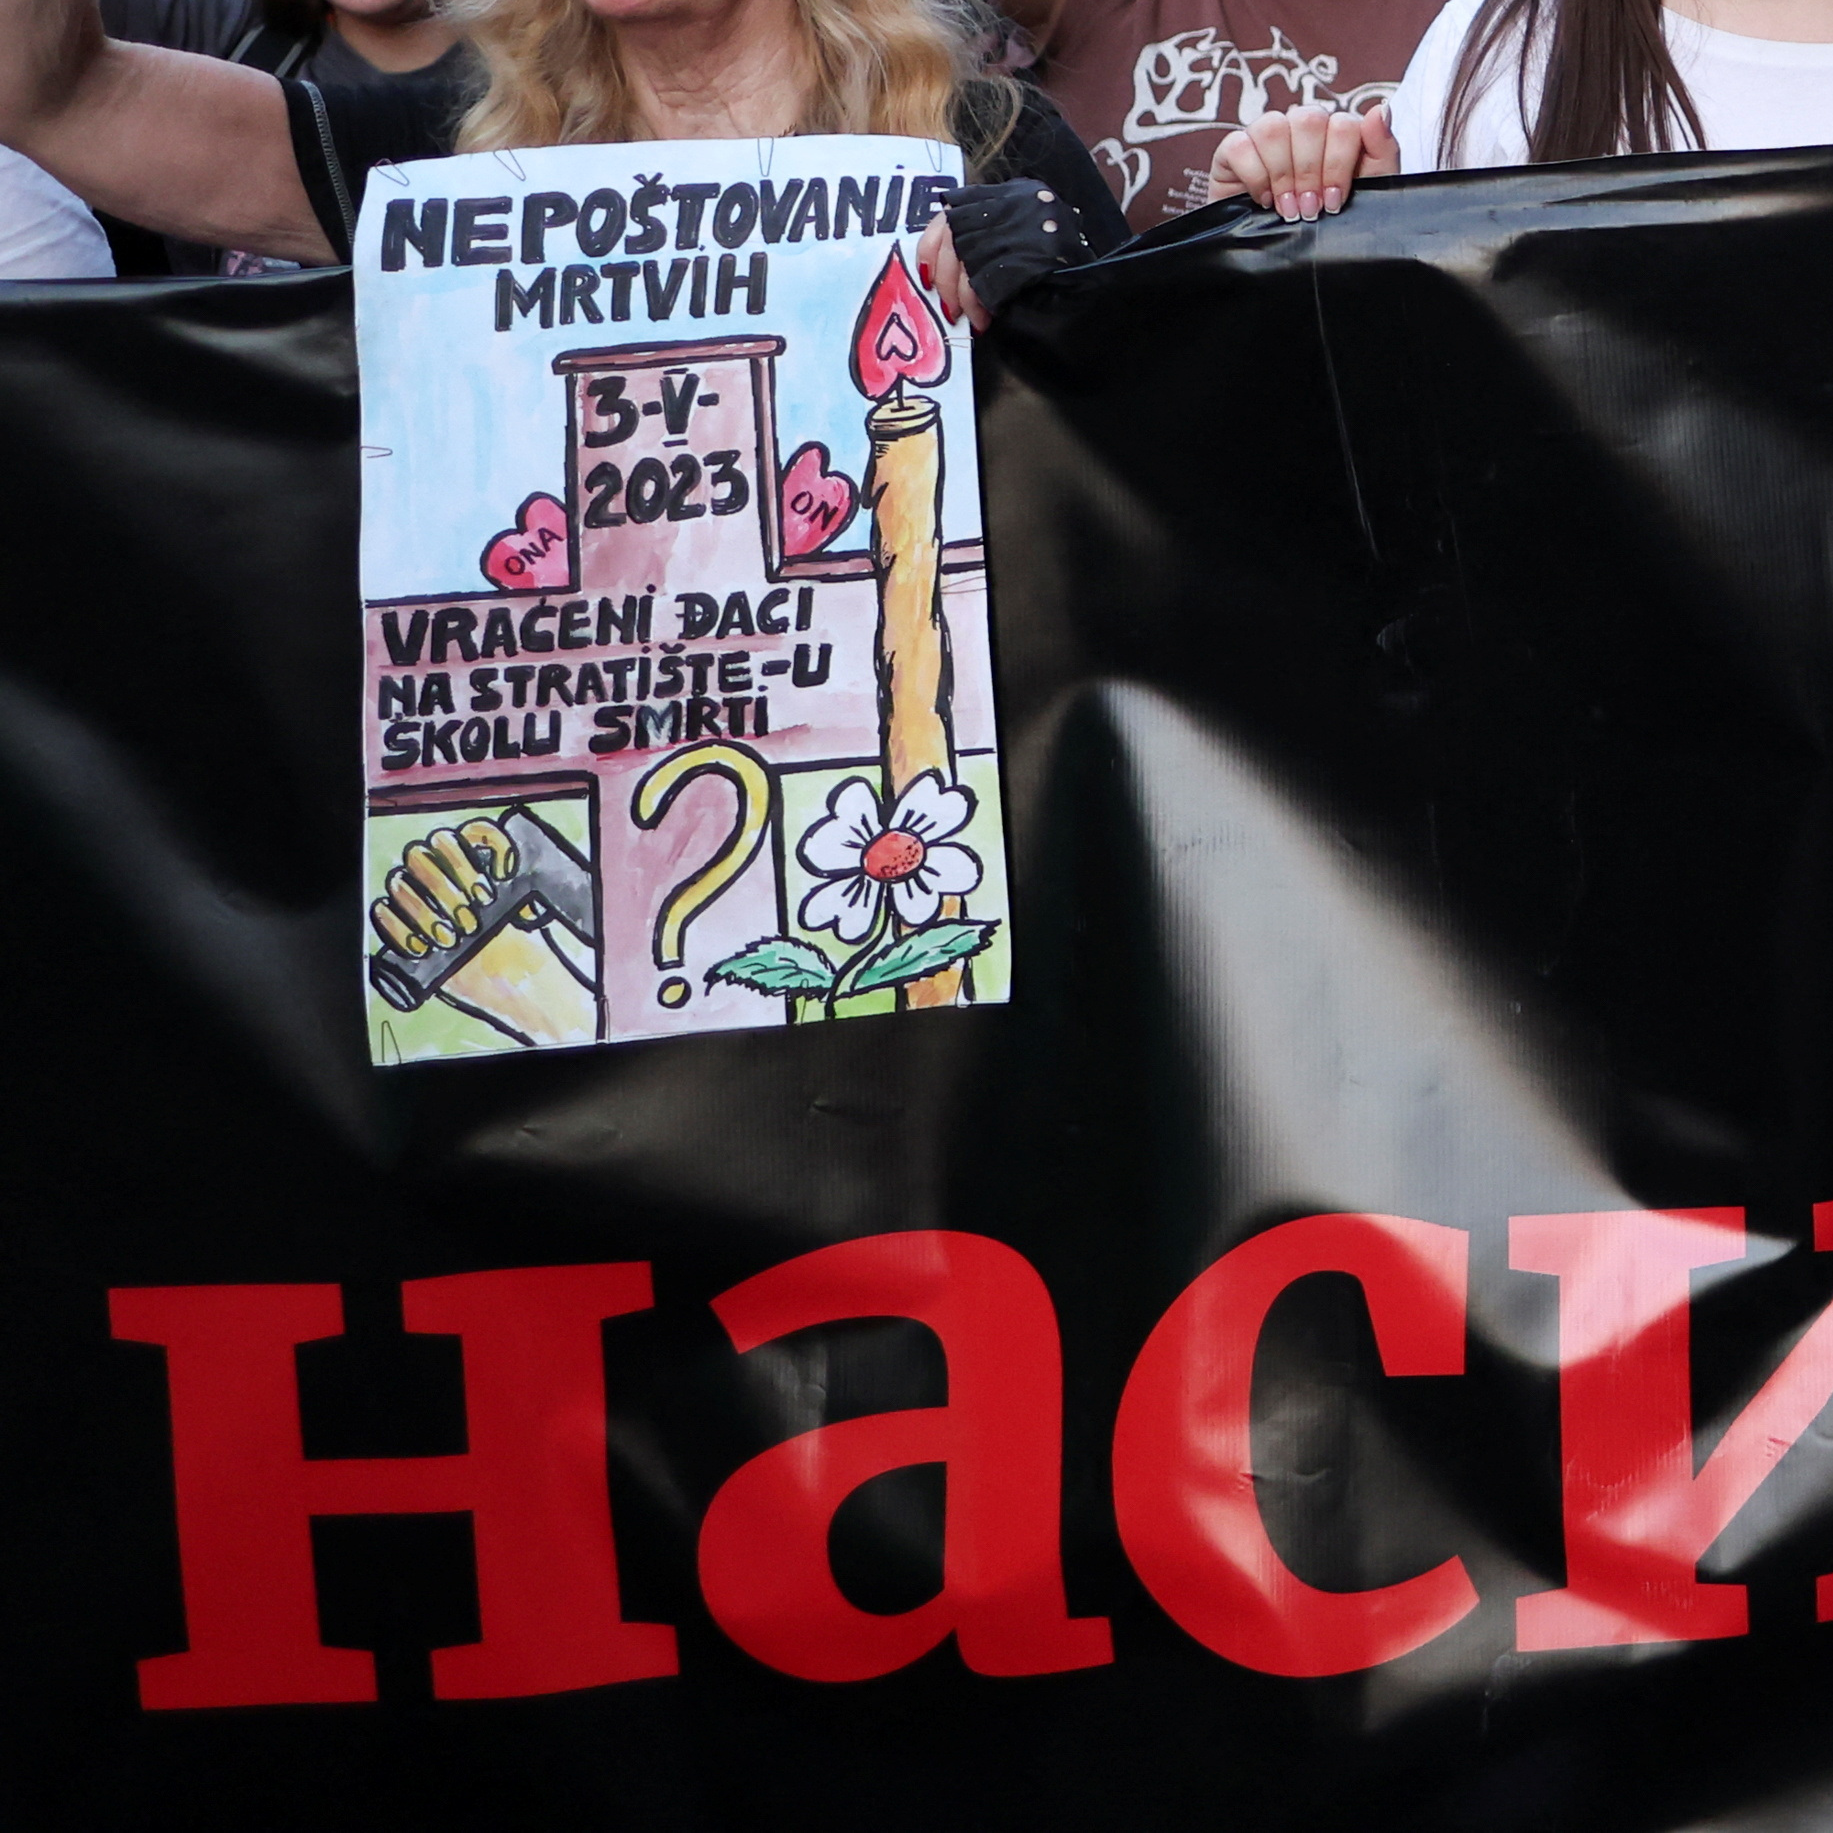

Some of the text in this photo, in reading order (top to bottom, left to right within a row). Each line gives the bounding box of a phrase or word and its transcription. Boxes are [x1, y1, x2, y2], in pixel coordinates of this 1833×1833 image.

[381, 165, 960, 272] NEPOŠTOVANJE
[494, 246, 767, 331] MRTVIH
[584, 449, 749, 529] 2023
[790, 490, 840, 531] ON
[504, 527, 566, 576] ONA
[377, 672, 456, 721] NA
[588, 685, 769, 753] SMRTI
